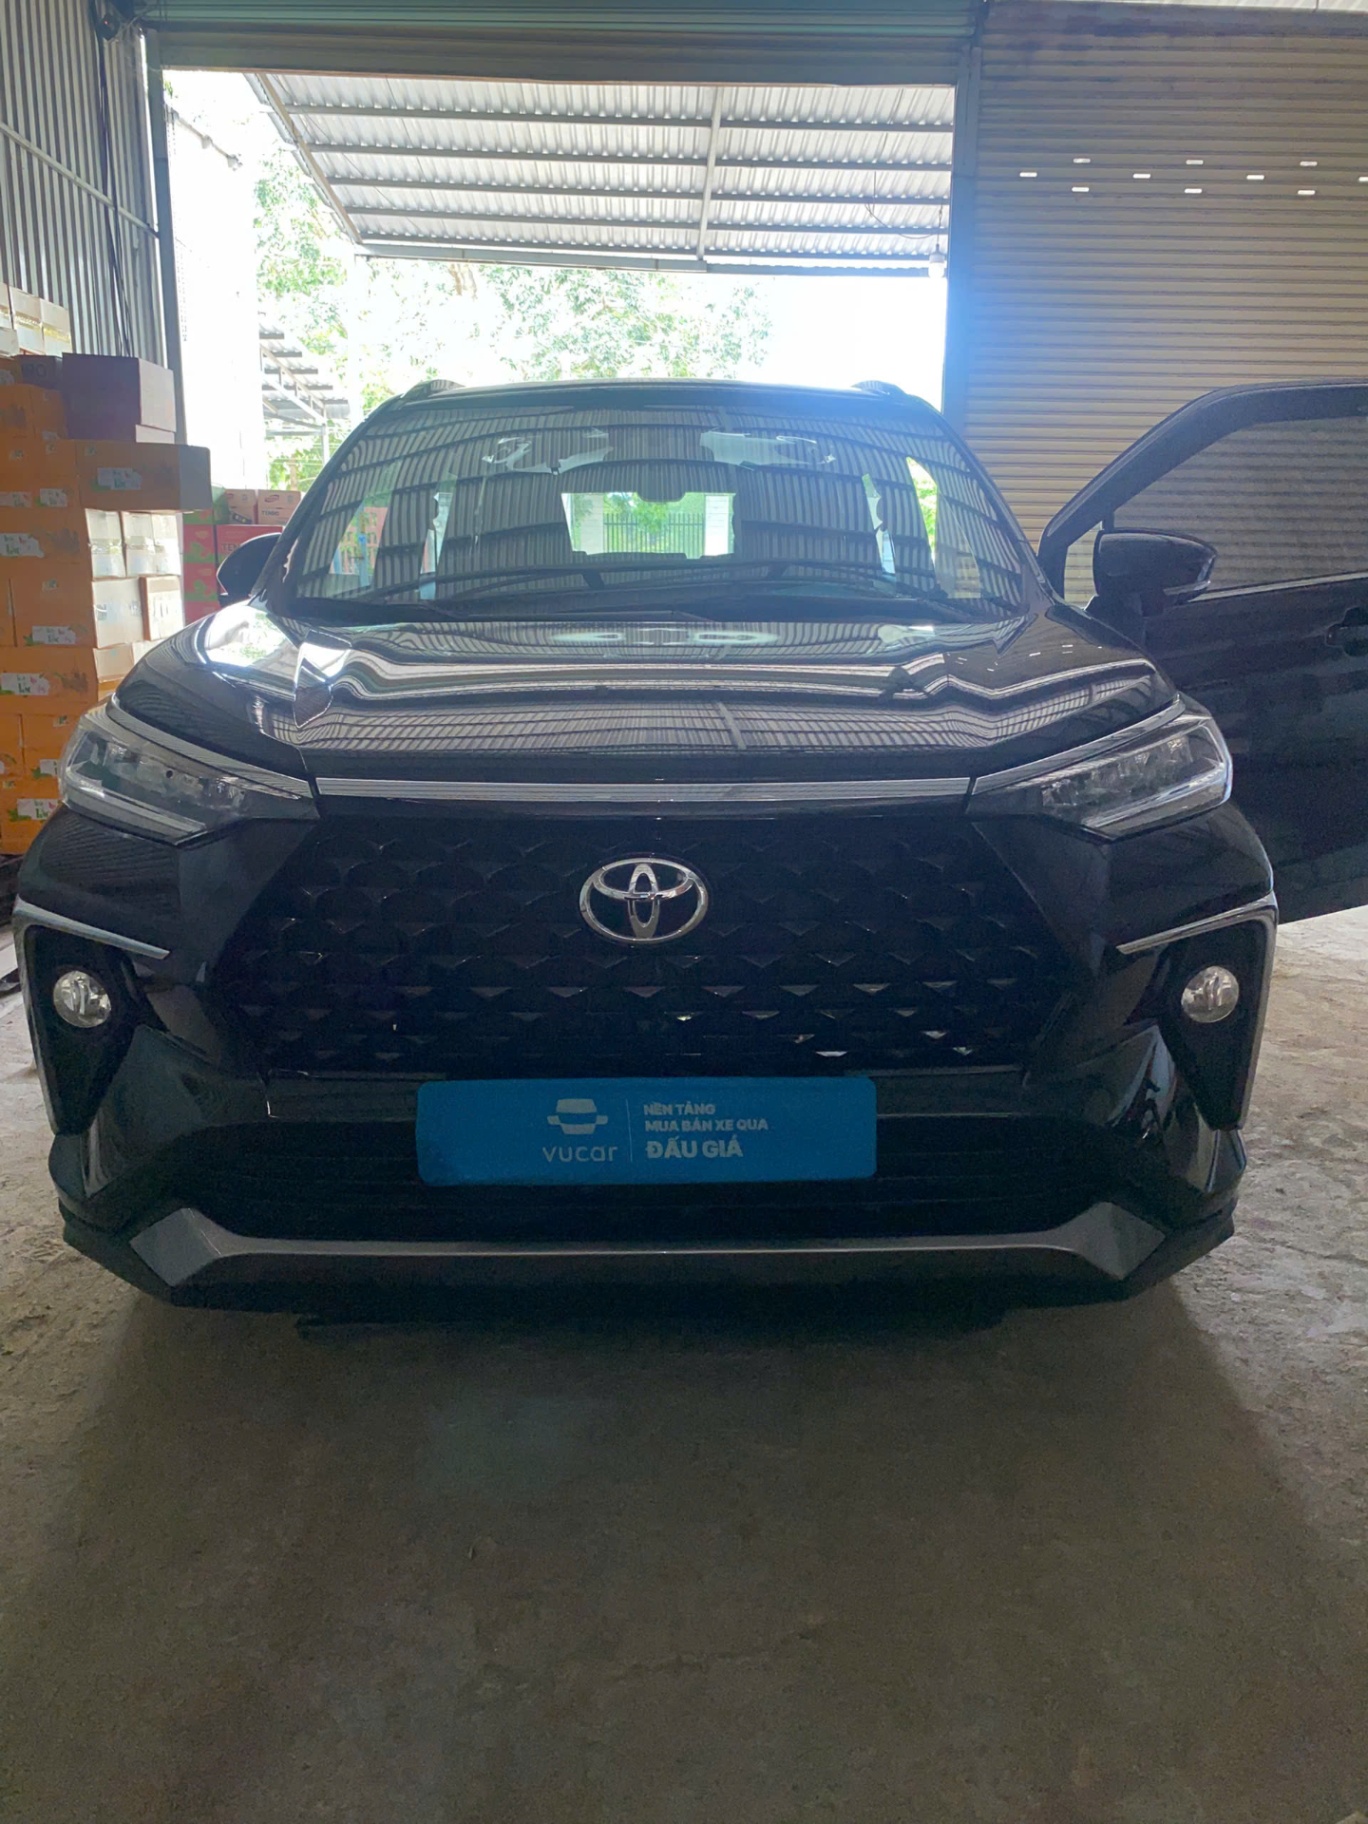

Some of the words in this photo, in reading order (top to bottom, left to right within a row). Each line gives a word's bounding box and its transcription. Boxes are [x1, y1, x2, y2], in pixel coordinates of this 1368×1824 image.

[675, 1100, 716, 1116] TẢNG
[645, 1119, 680, 1132] MUA
[682, 1117, 713, 1132] BÁN
[715, 1119, 734, 1132] XE
[736, 1118, 769, 1131] QUA
[542, 1145, 619, 1163] vucar
[645, 1135, 698, 1159] ĐẤU
[702, 1134, 744, 1159] GIÁ
